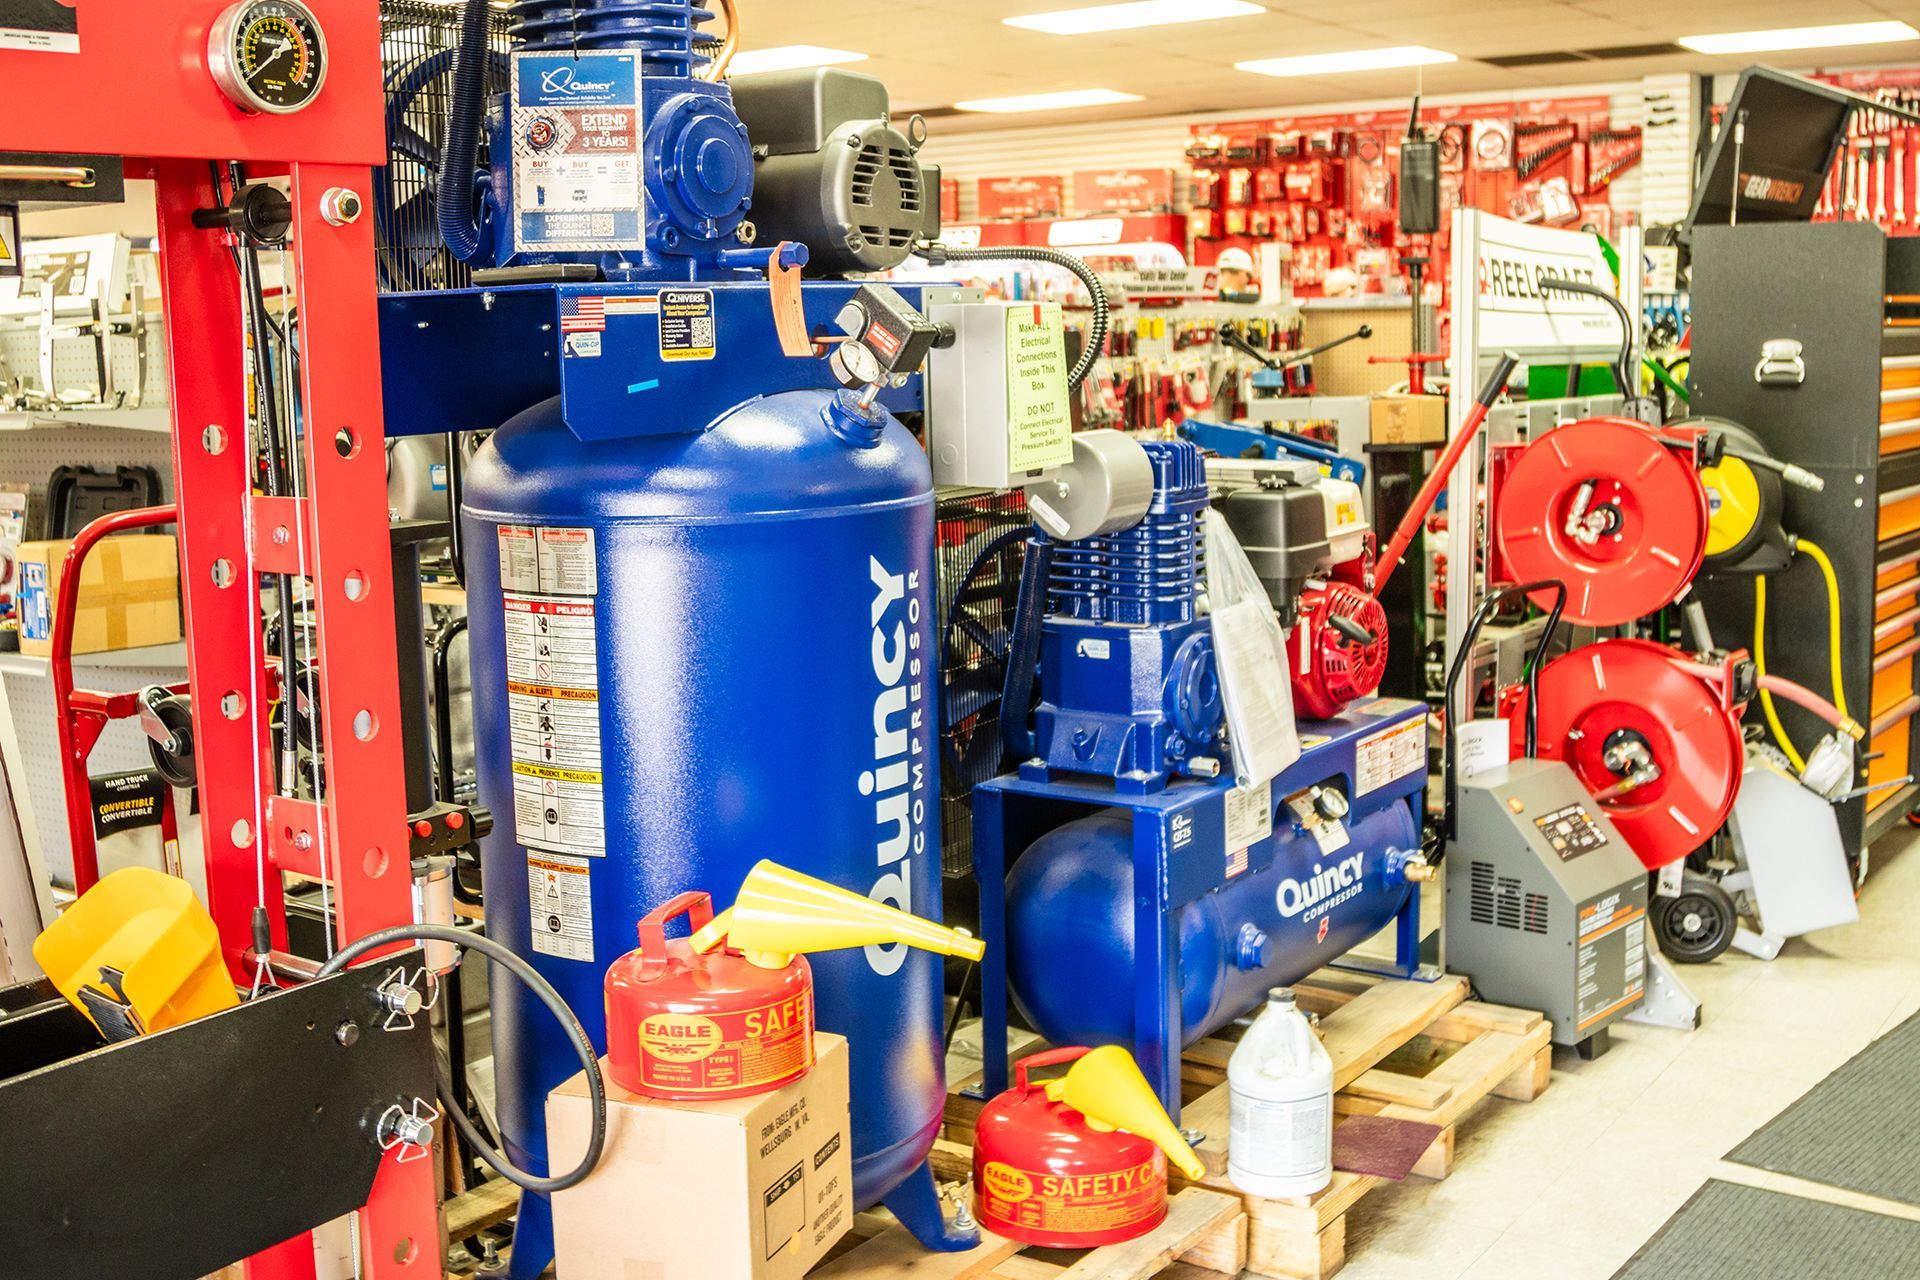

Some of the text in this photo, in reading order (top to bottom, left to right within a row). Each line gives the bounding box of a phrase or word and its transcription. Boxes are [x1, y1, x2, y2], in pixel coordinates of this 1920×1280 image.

[570, 82, 610, 90] Quincy
[581, 114, 628, 126] EXTEND
[583, 136, 629, 147] 3 YEARS!
[1744, 175, 1804, 204] GEARWRENCH
[545, 214, 592, 222] EXPERIENCE
[546, 230, 592, 238] DIFFERENCE
[1491, 258, 1600, 300] REELCRAFT
[1019, 324, 1036, 332] Make
[1020, 336, 1050, 348] Electrical
[1016, 351, 1057, 363] Connections
[1020, 364, 1056, 377] Inside This
[1028, 402, 1054, 415] DO NOT
[1020, 421, 1040, 430] Connect
[505, 602, 592, 614] DANGER PELIGRO
[908, 569, 925, 855] COMPRESSOR
[514, 764, 531, 772] CAUTION
[540, 768, 560, 778] PRUDENCE
[858, 554, 911, 976] Quincy
[105, 774, 149, 788] HAND TRUCK
[99, 797, 154, 815] CONVERTIBLE
[101, 807, 152, 823] CONVERTIBLE
[1276, 852, 1364, 918] Quincy
[1303, 882, 1363, 923] COMPRESSOR
[645, 1022, 711, 1038] EAGLE
[708, 1056, 728, 1065] TYPE
[776, 1110, 789, 1130] EAGLE
[760, 1126, 792, 1159] WELLSBURG
[815, 1134, 840, 1166] CONTENTS
[986, 1166, 1025, 1188] EAGLE
[1043, 1169, 1135, 1197] SAFETY
[813, 1194, 843, 1230] ANOTHER QUALITY
[815, 1210, 842, 1246] EAGLE PRODUCT
